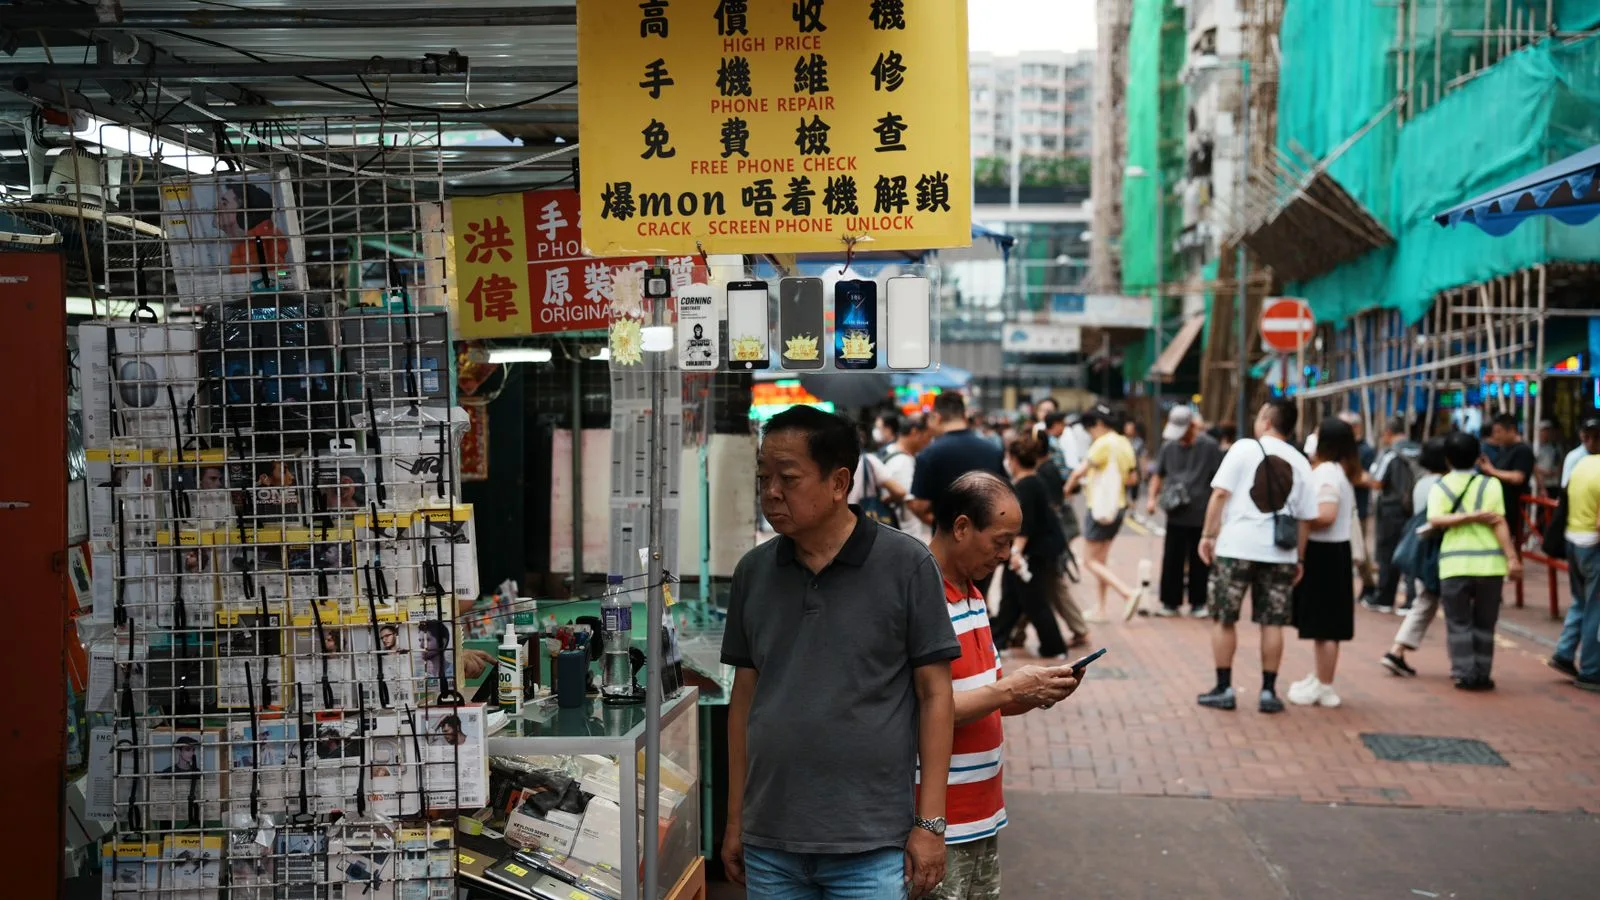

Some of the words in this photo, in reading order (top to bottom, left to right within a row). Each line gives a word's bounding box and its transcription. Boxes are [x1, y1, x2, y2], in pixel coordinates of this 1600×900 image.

[639, 0, 906, 38] 高價收機
[723, 37, 766, 53] HIGH
[774, 35, 822, 51] PRICE
[638, 50, 908, 99] 手機維修
[711, 97, 769, 114] PHONE
[777, 95, 836, 113] REPAIR
[640, 111, 909, 159] 免費檢查
[690, 159, 729, 175] FREE
[737, 157, 795, 174] PHONE
[803, 156, 857, 172] CHECK
[873, 170, 951, 214] 解鎖
[637, 221, 691, 237] CRACK
[708, 219, 770, 236] SCREEN
[775, 217, 833, 234] PHONE
[846, 215, 914, 232] UNLOCK
[463, 215, 520, 323] 洪偉
[680, 296, 712, 305] CORNING
